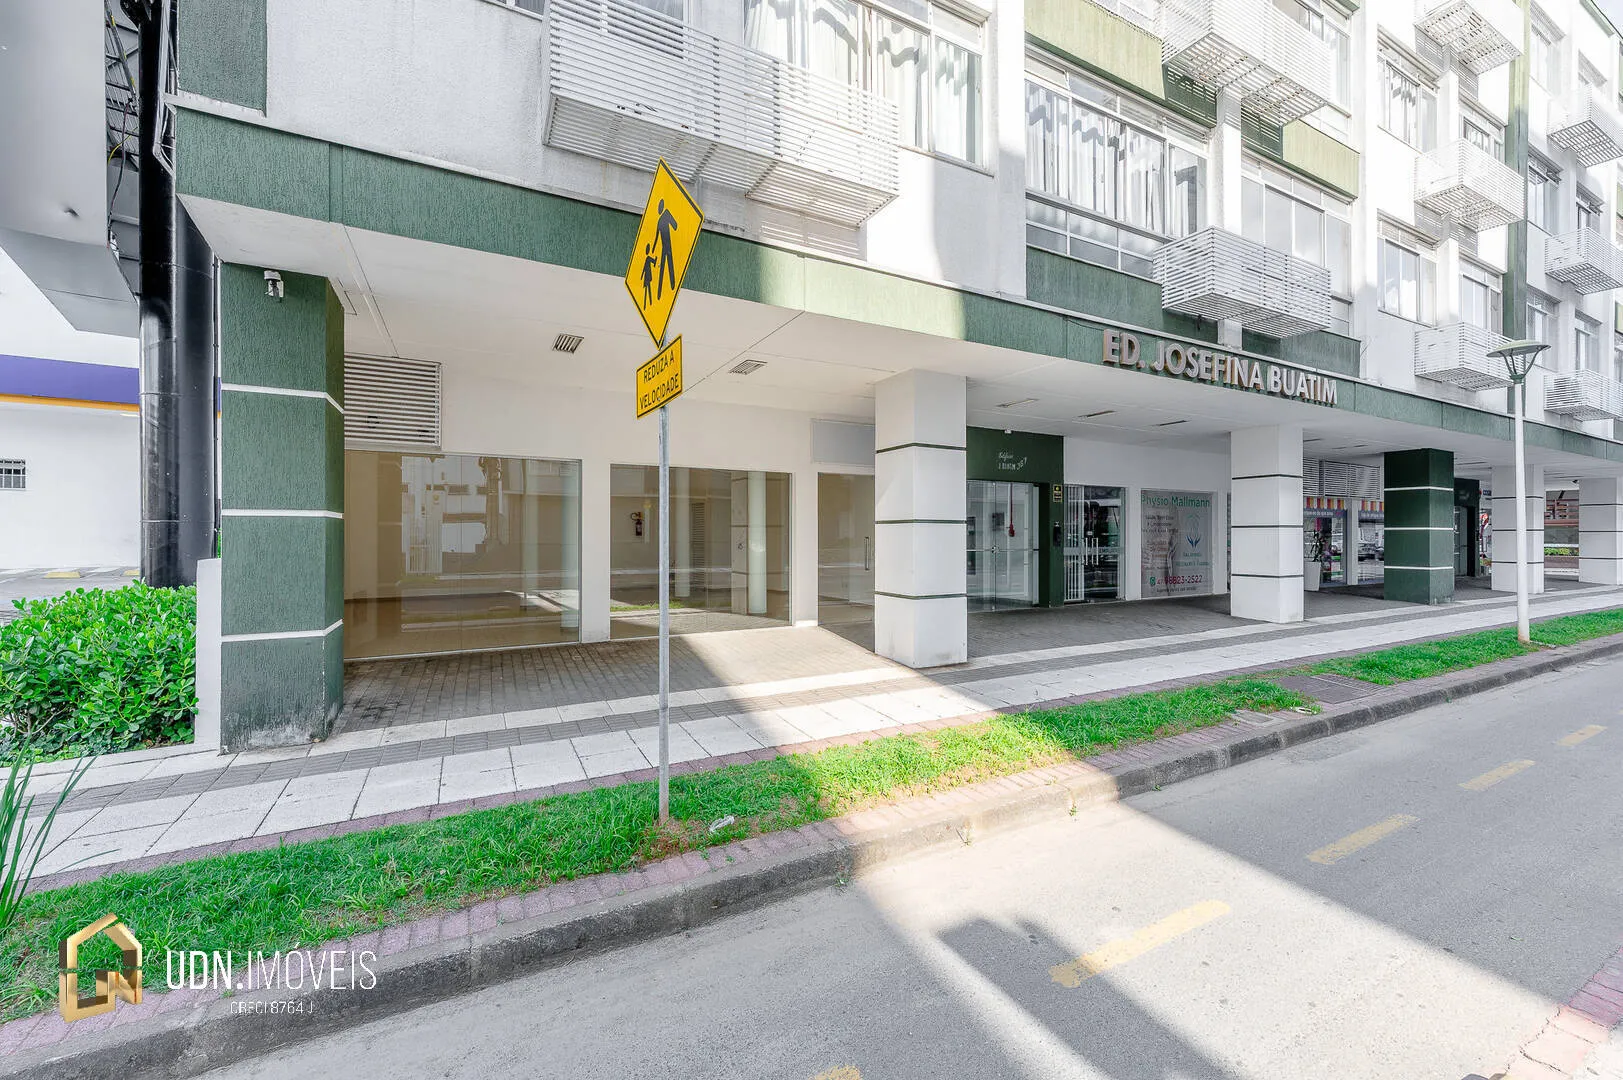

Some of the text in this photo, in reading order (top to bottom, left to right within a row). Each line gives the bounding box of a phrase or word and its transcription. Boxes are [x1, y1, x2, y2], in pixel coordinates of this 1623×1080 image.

[643, 349, 675, 384] REDUZA A
[1103, 328, 1338, 406] ED. JOSEFINA BUATIM
[639, 373, 679, 410] VELOCIDADE
[1141, 494, 1210, 508] Physio Mallmann
